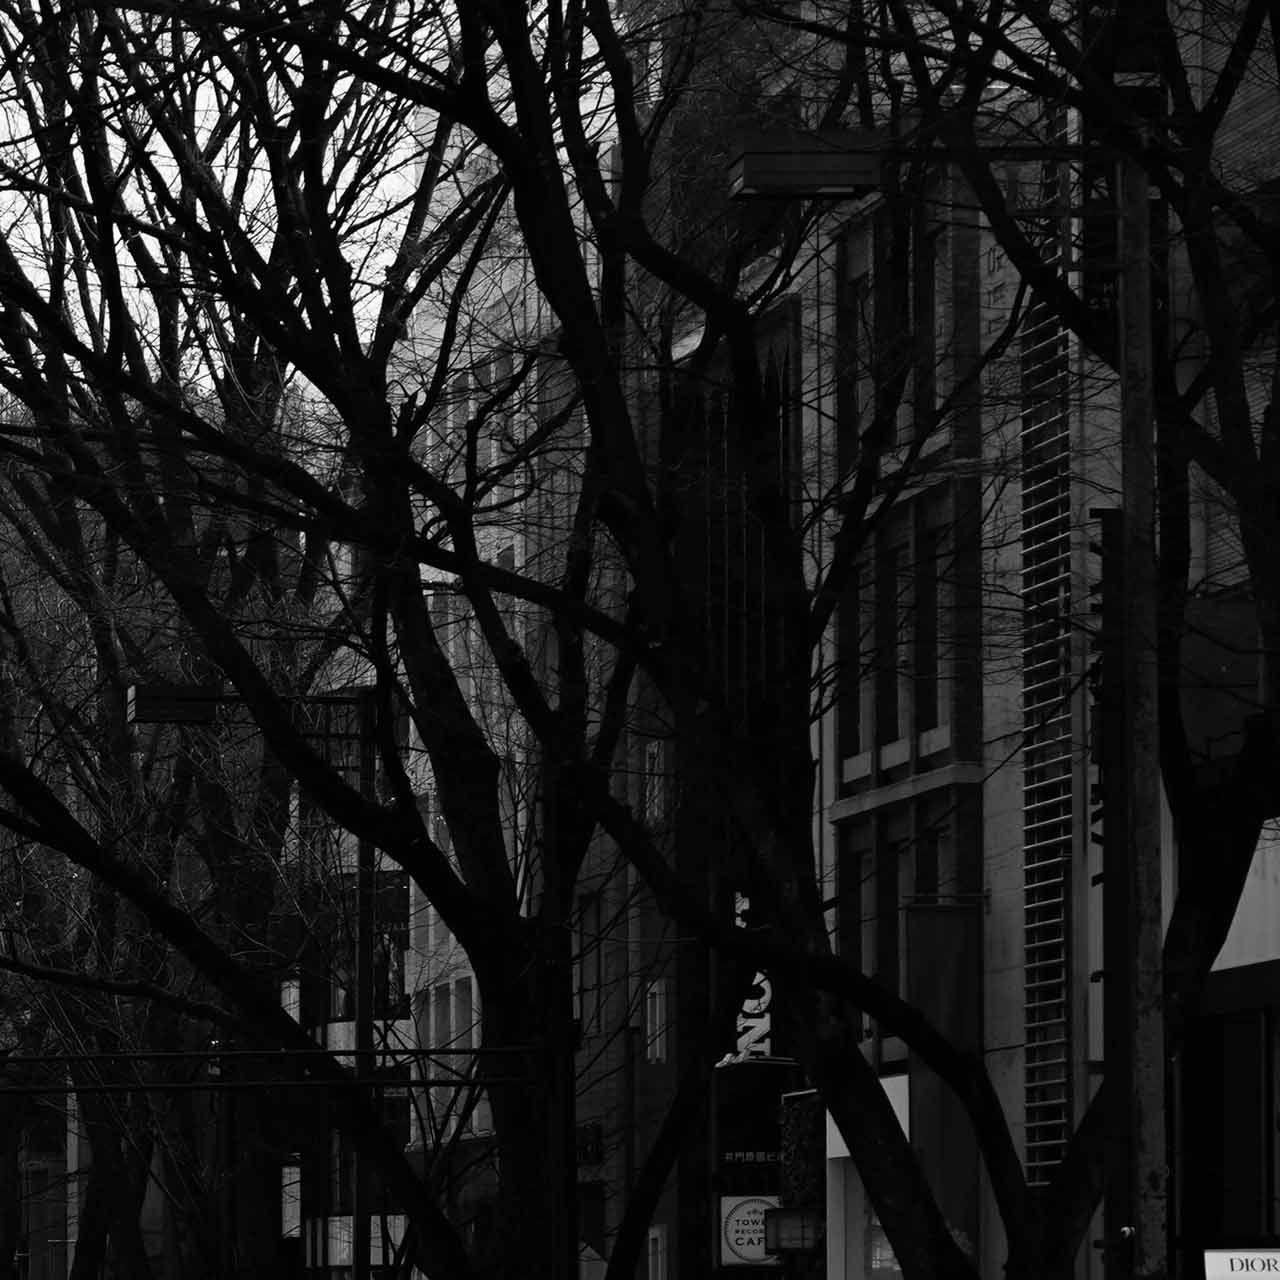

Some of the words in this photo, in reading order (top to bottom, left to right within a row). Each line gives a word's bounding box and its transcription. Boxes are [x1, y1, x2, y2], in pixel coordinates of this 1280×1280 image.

[735, 1219, 765, 1227] TOW
[735, 1237, 766, 1246] CAF
[1230, 1258, 1280, 1272] DIOR
